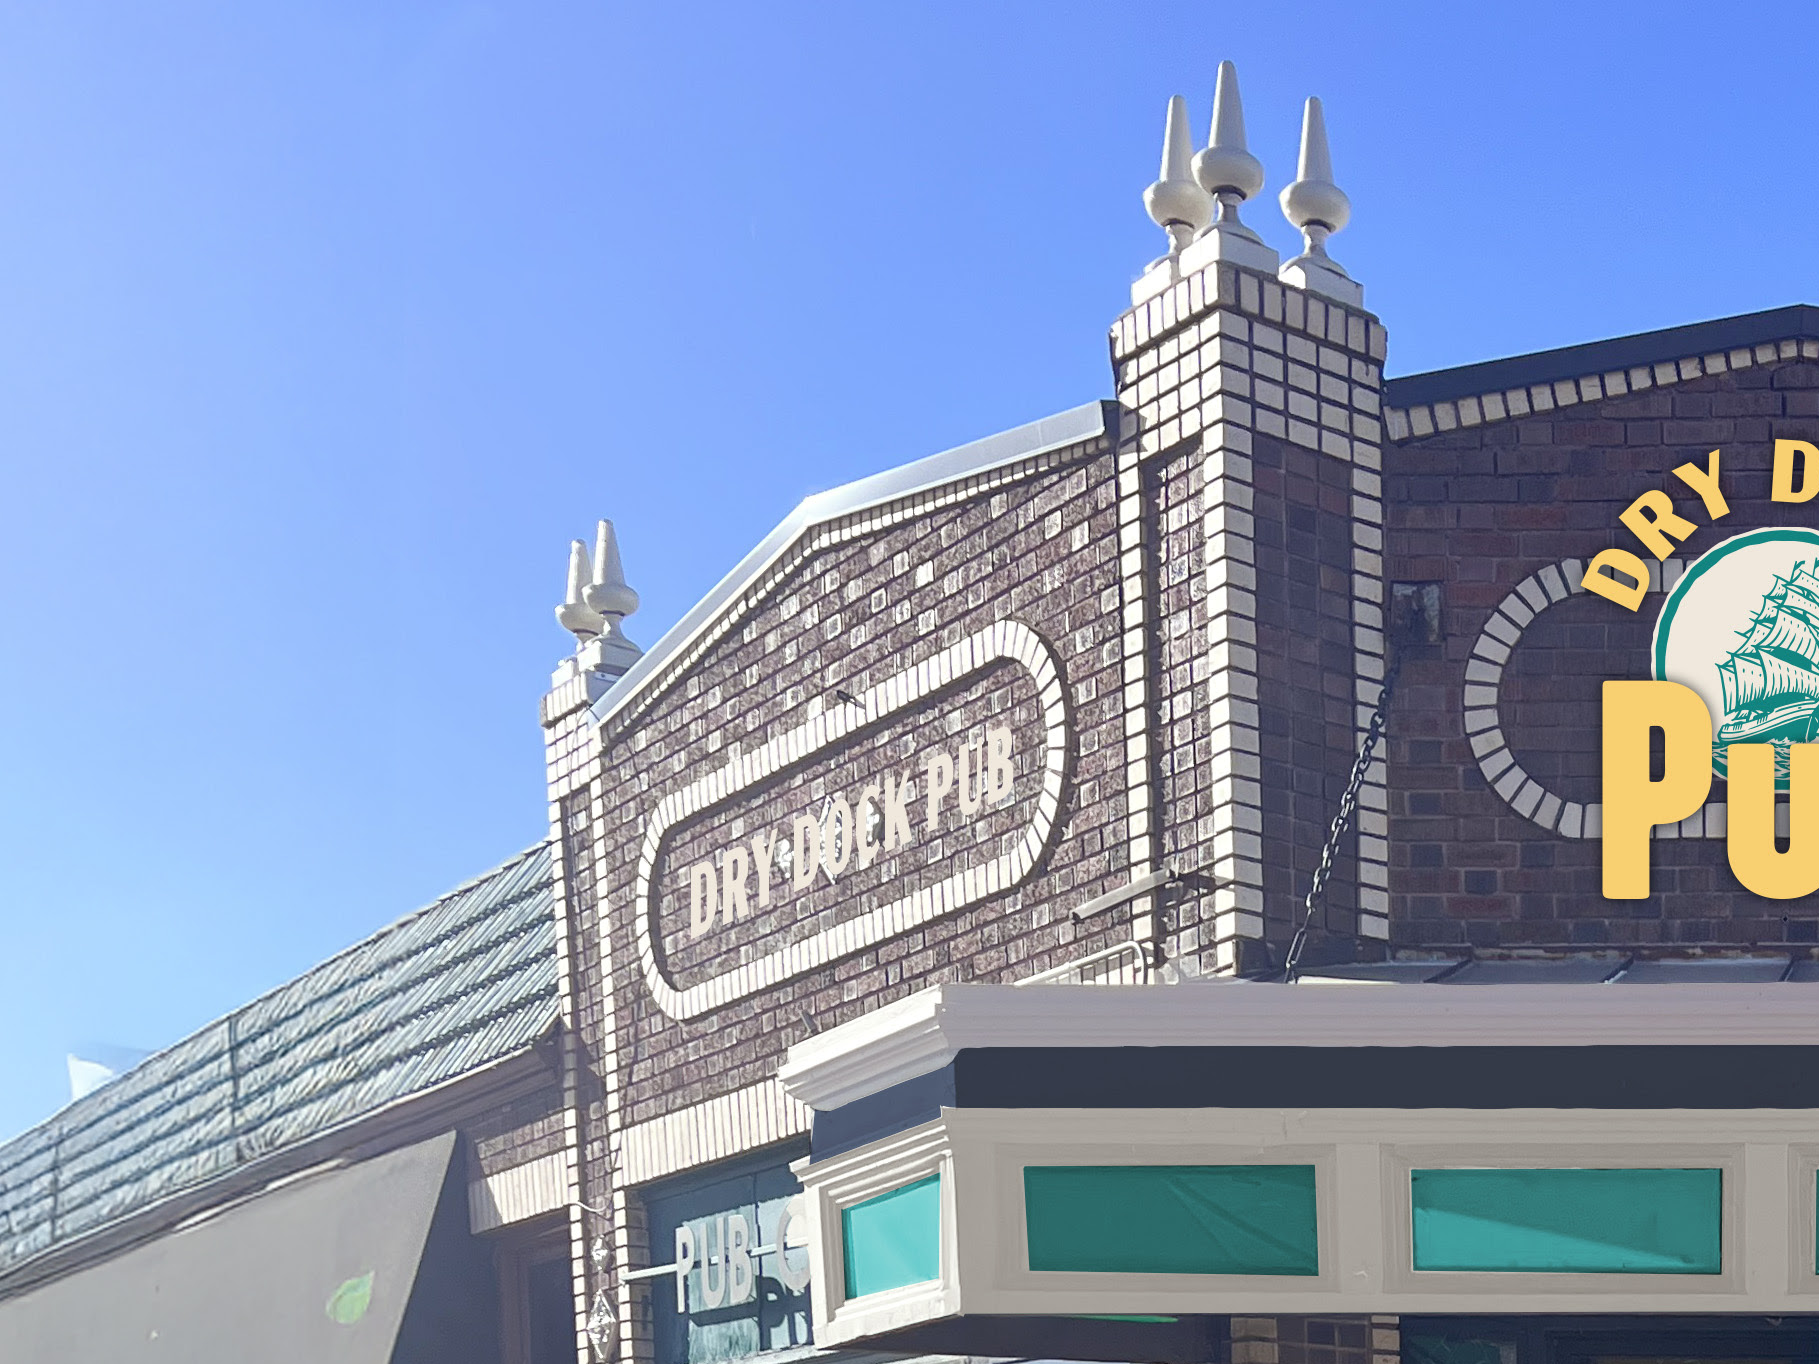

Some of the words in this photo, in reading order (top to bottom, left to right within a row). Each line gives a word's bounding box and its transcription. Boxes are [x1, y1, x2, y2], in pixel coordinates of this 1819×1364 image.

[1580, 448, 1730, 613] DRY
[690, 827, 779, 940] DRY
[792, 769, 912, 892] DOCK
[927, 726, 1015, 831] PUB
[675, 1214, 752, 1314] PUB
